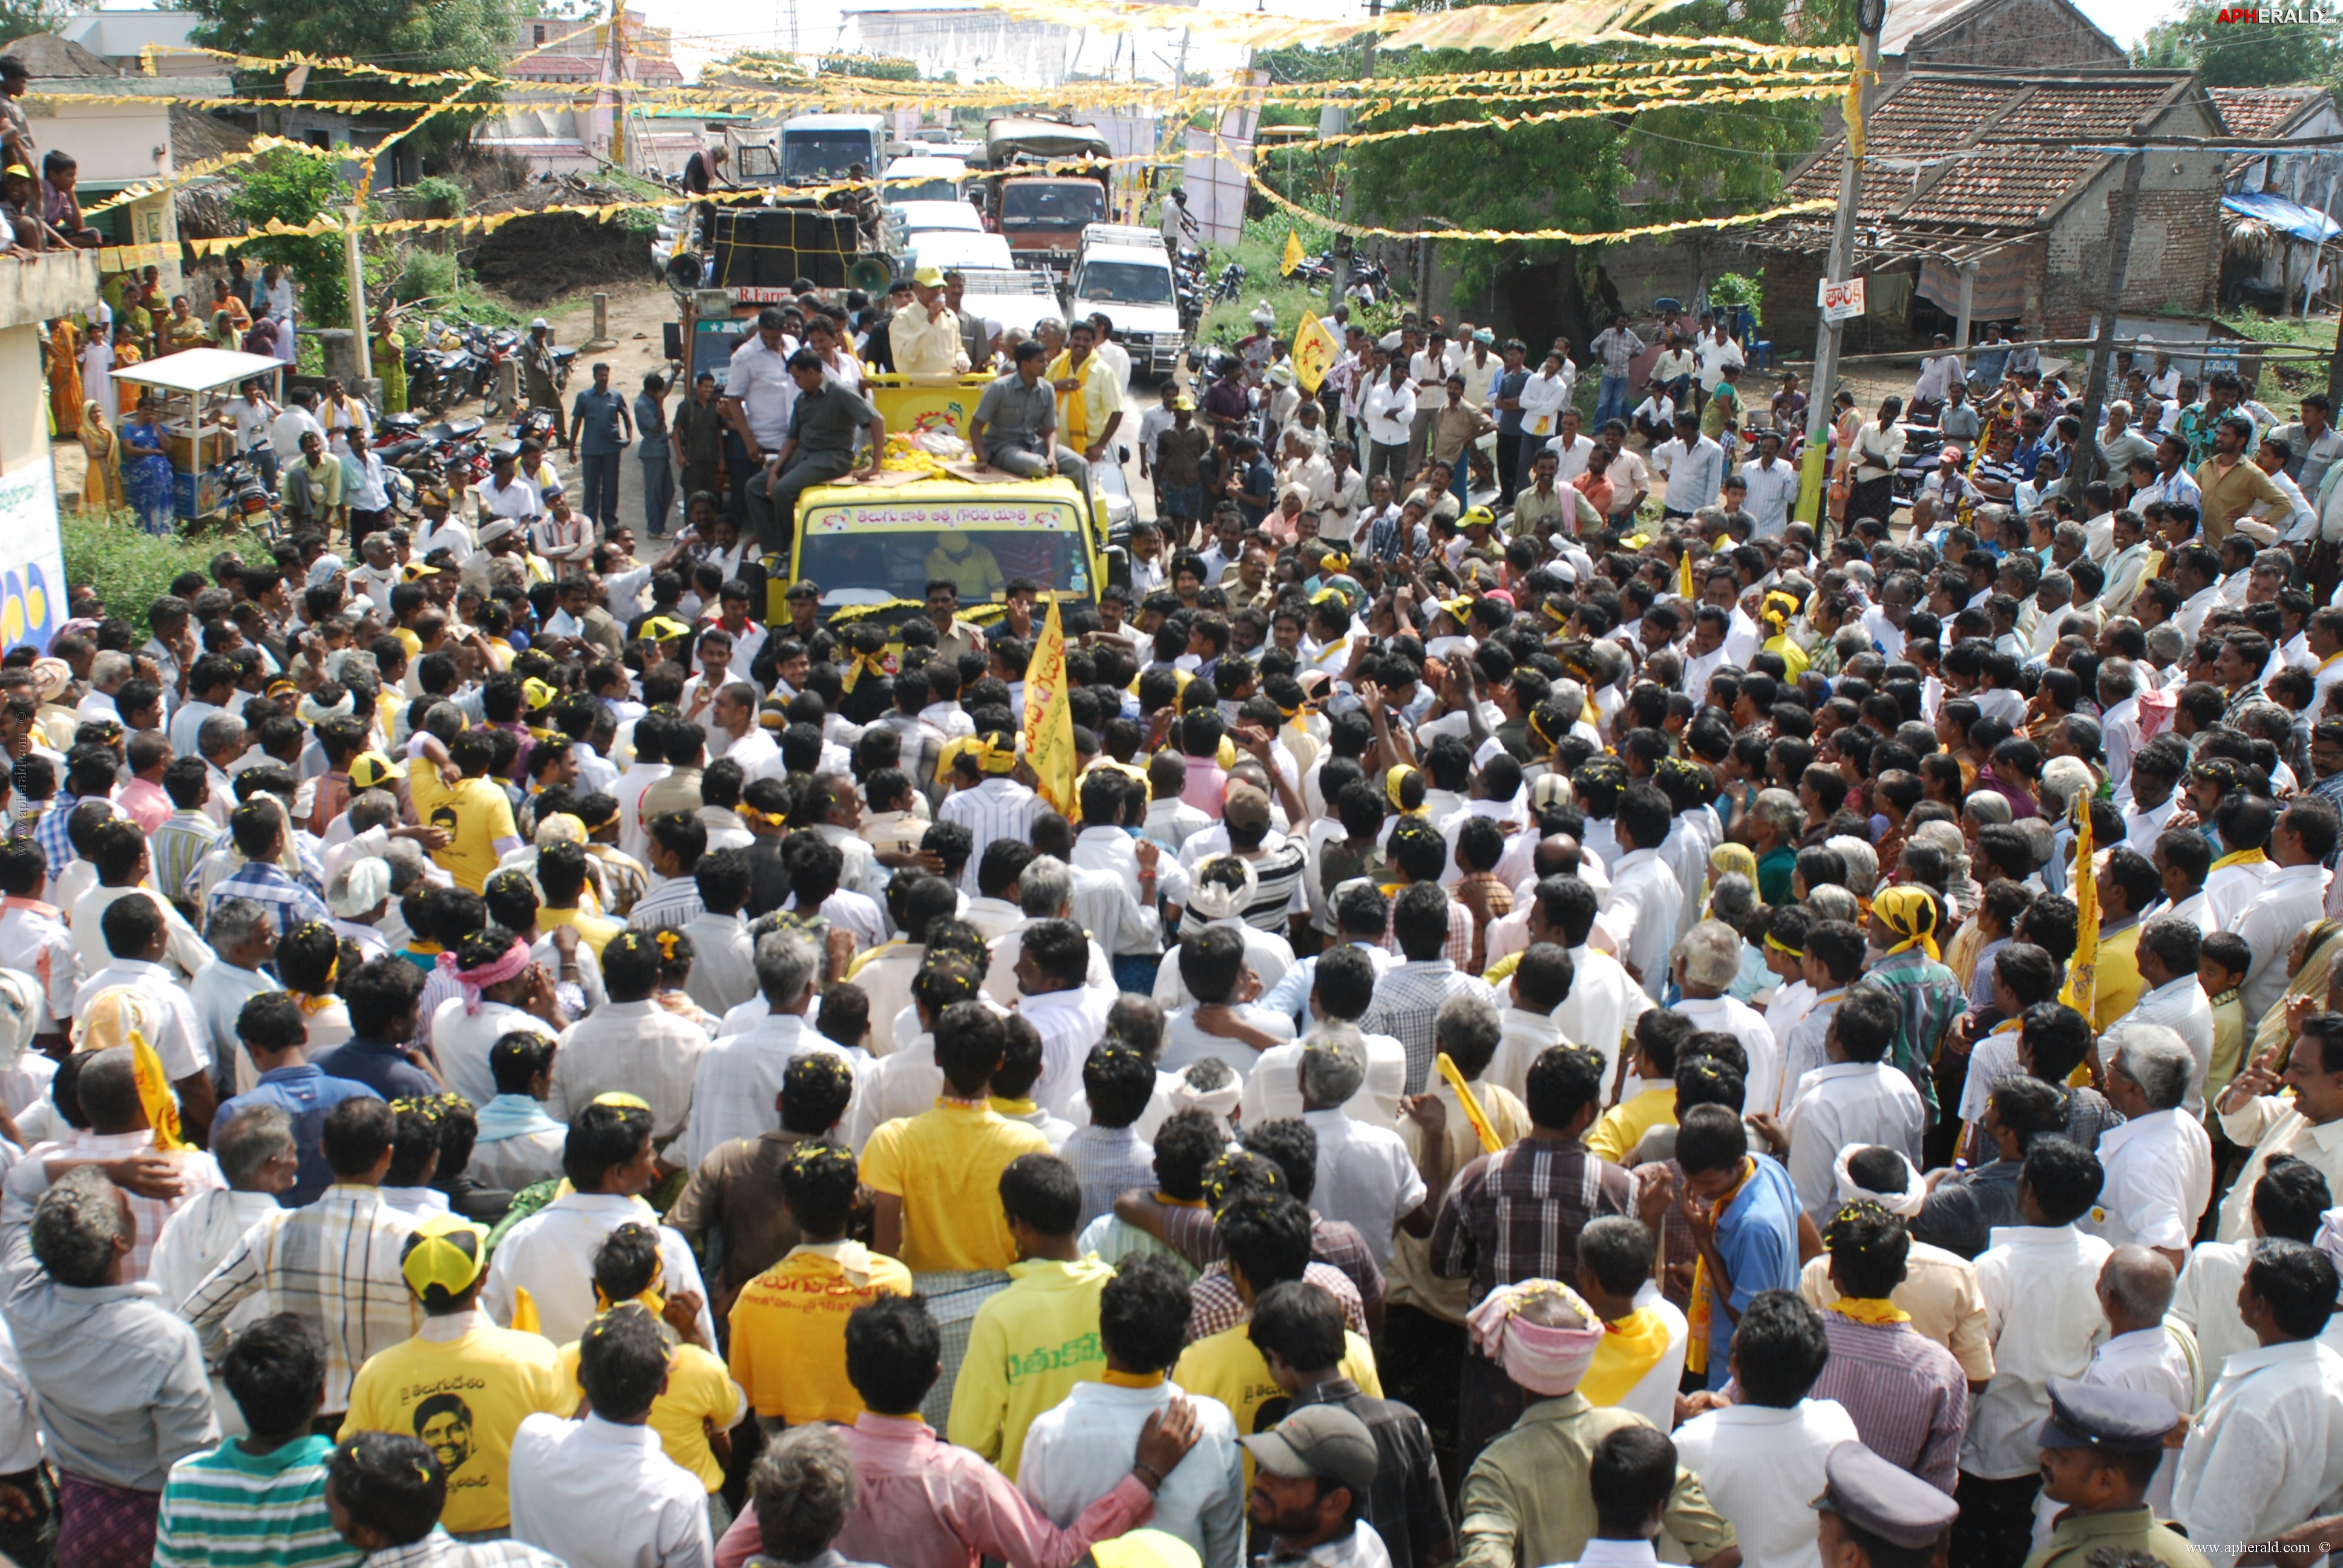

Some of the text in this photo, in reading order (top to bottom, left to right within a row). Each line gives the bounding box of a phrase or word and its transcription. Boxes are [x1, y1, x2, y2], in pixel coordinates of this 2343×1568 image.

[1826, 281, 1861, 308] తారక్
[857, 509, 1026, 528] తెలుగు జాతి ఆత్మ గౌరవ యాత్ర
[401, 1375, 485, 1405] జై తెలుగుదేశం
